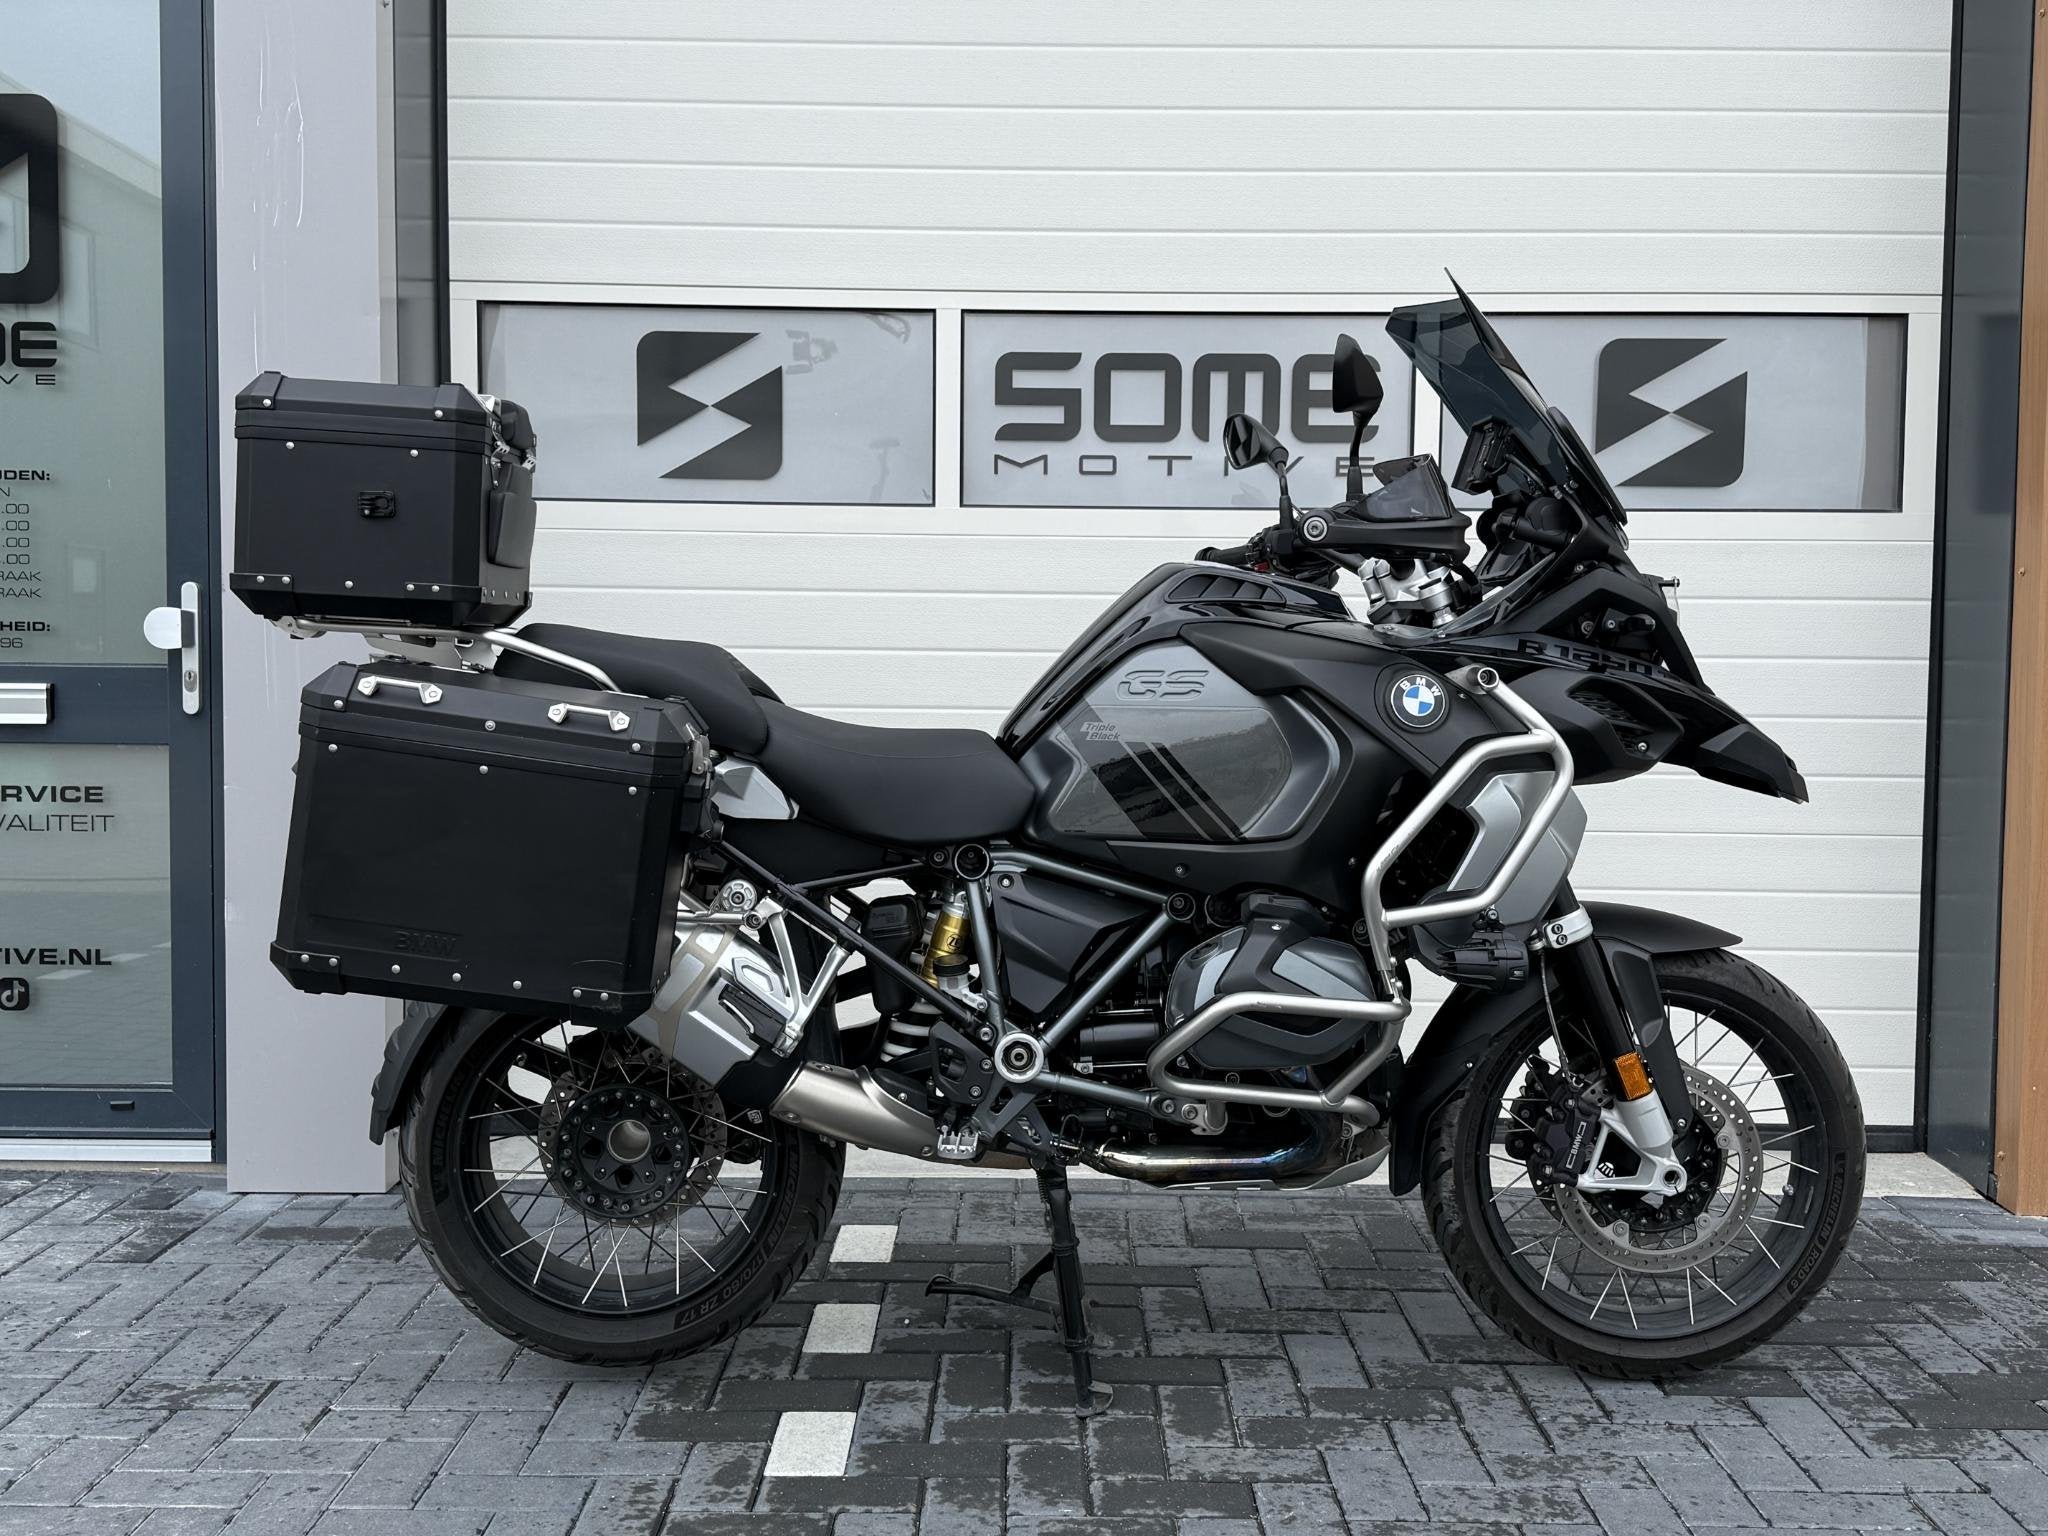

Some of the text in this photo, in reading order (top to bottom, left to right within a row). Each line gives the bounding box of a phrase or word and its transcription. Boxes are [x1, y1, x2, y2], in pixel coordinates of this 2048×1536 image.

[0, 321, 57, 368] E
[994, 351, 1382, 443] SOME
[0, 470, 50, 480] DEN:
[0, 621, 51, 631] HEID:
[1116, 669, 1210, 701] GS
[1399, 676, 1442, 697] BMW
[1085, 722, 1116, 733] Triple
[1089, 731, 1121, 741] Black
[0, 785, 104, 803] RVICE
[0, 813, 115, 832] ALITEIT
[0, 948, 112, 966] IVE.NL
[1570, 1133, 1583, 1155] BMW
[1798, 1249, 1820, 1279] ROAD
